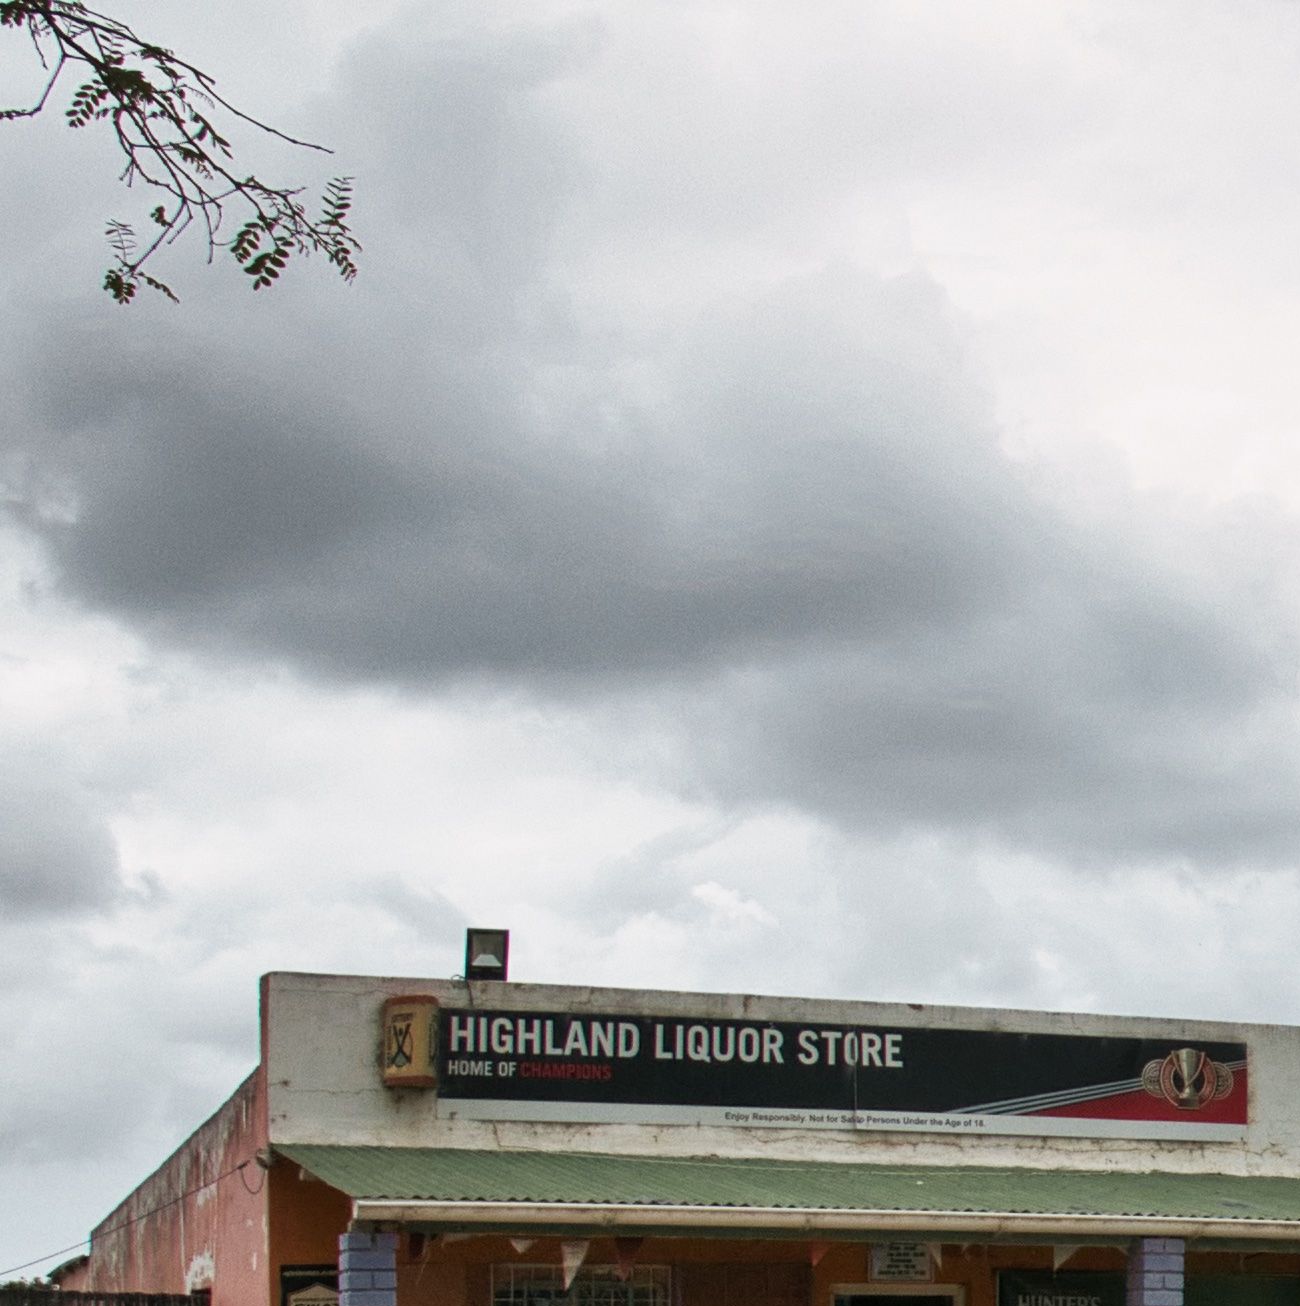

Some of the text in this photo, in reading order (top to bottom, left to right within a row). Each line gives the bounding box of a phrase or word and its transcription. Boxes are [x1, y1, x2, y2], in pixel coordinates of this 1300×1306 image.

[451, 1016, 903, 1068] HIGHLAND LIQUOR STORE
[448, 1060, 612, 1080] HOME OF CHAMPIONS
[724, 1112, 750, 1122] Enjoy
[810, 1114, 825, 1122] Not
[827, 1114, 838, 1122] for
[867, 1116, 900, 1125] Persons
[903, 1118, 927, 1126] Under
[930, 1118, 943, 1126] the
[964, 1119, 972, 1127] of
